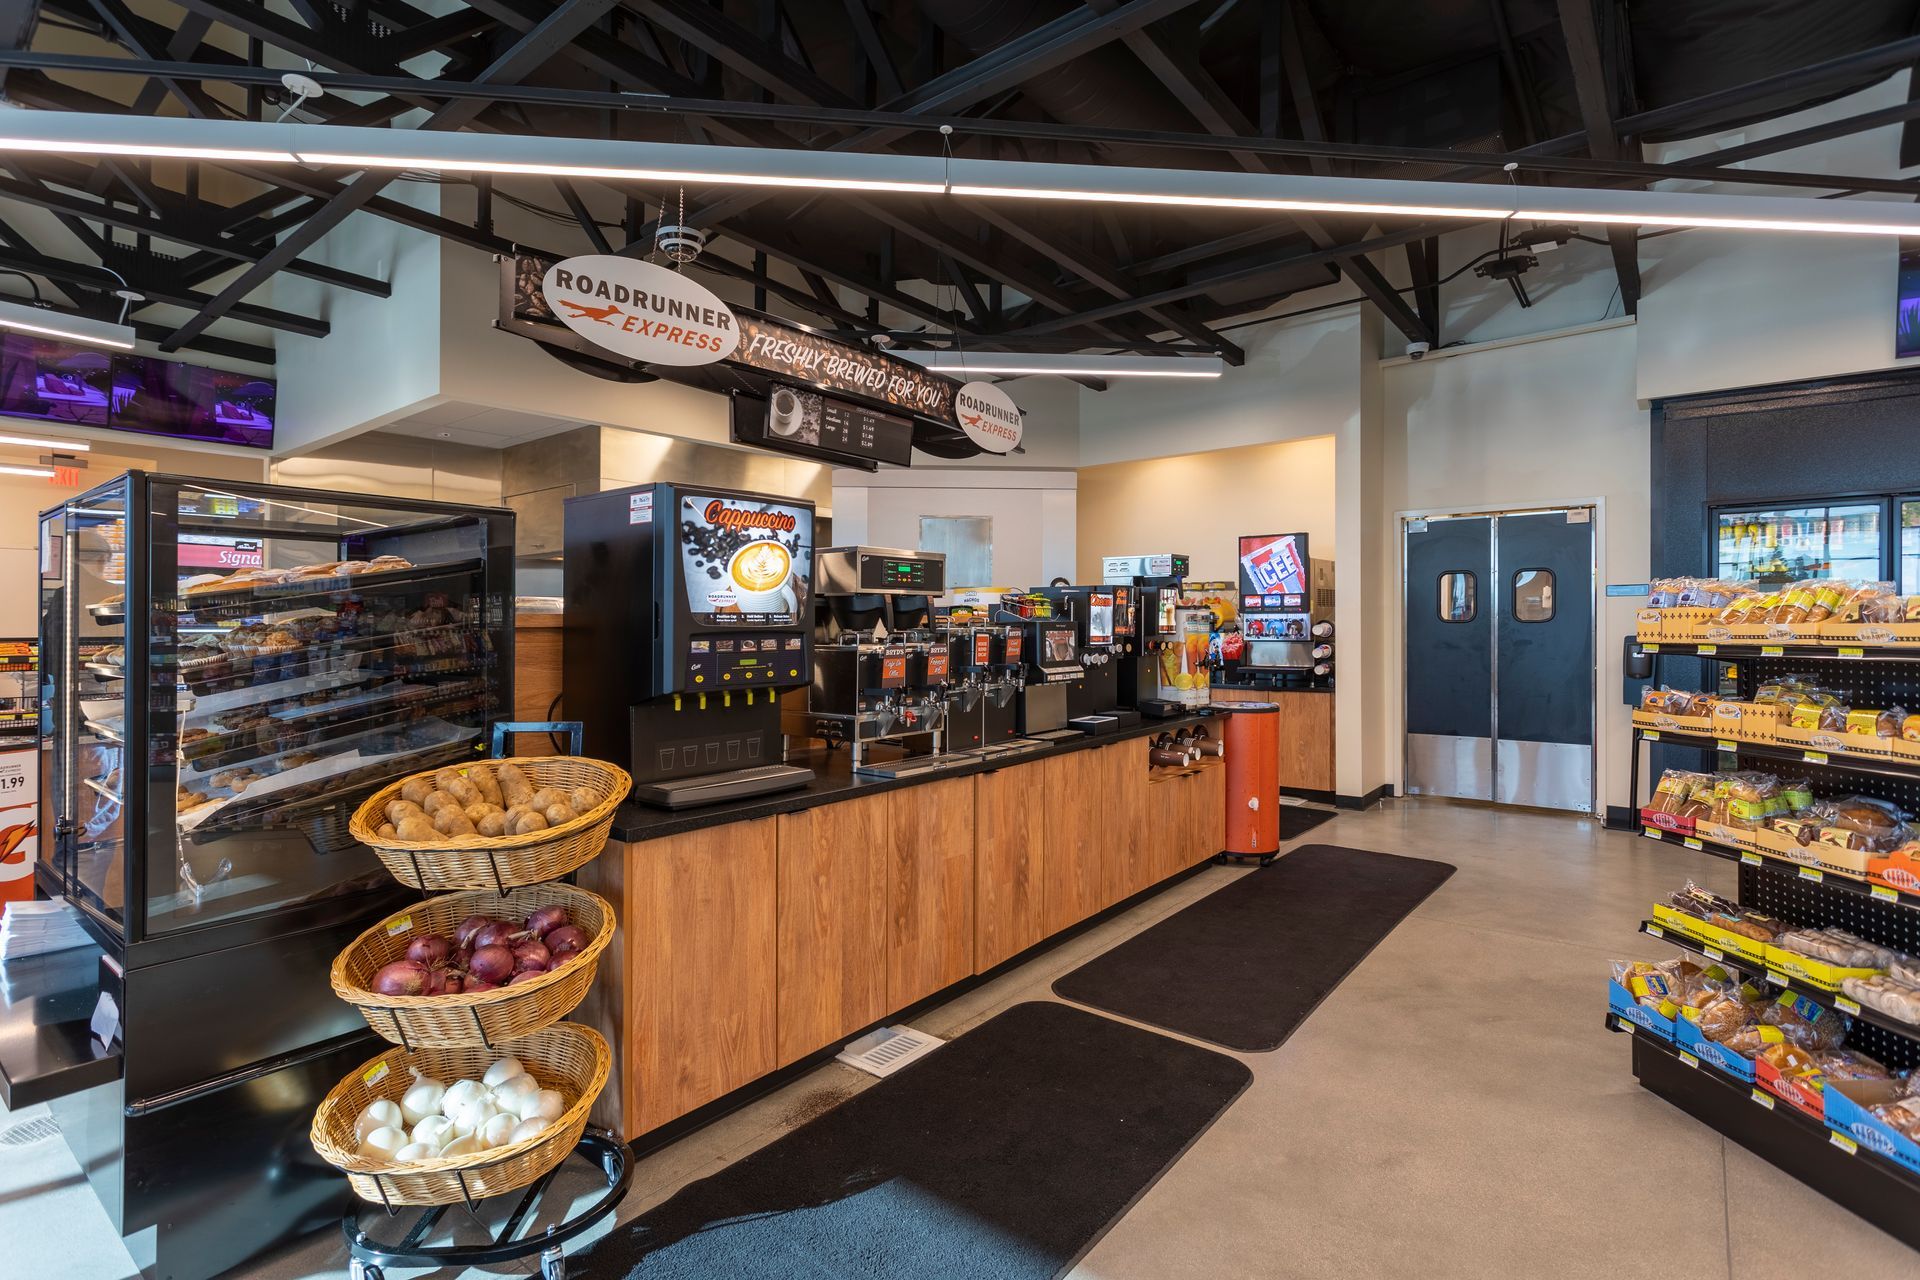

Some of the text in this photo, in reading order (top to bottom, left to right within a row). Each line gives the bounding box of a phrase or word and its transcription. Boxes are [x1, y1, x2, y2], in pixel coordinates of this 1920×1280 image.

[556, 268, 731, 331] ROADRUNNER
[621, 315, 723, 353] EXPRESS
[750, 333, 942, 408] FRESHLY BREWED FOR YOU
[825, 415, 841, 424] Medium
[960, 392, 1020, 426] ROADRUNNER
[825, 424, 836, 432] Large
[981, 420, 1017, 442] EXPRESS
[704, 499, 796, 534] Cappuccino
[1252, 551, 1298, 590] ICEE
[886, 648, 905, 656] BOYD'S
[930, 646, 948, 654] BOYD'S
[1, 776, 25, 790] 1.99
